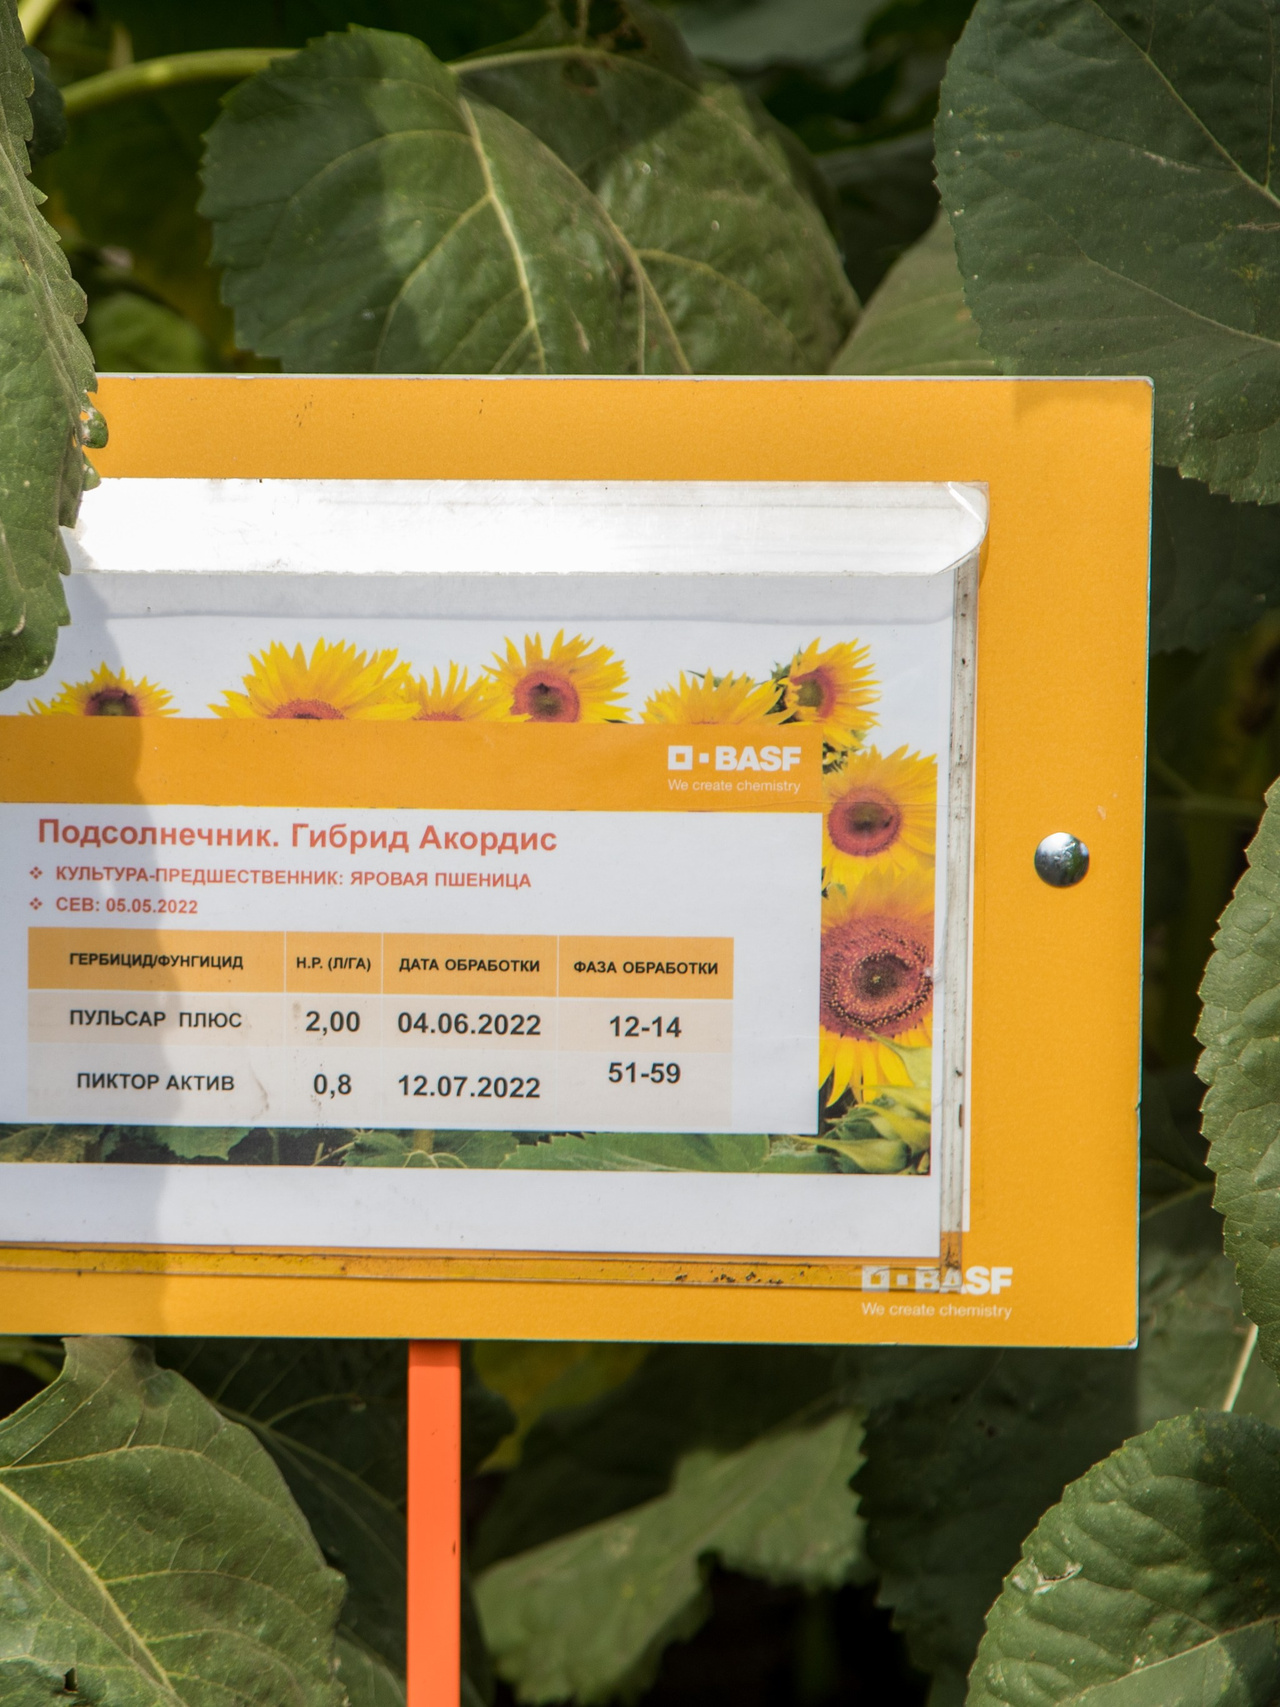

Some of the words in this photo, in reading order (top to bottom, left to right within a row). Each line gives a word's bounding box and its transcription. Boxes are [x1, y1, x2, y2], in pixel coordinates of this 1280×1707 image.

[715, 745, 802, 772] BASF
[668, 779, 689, 791] We
[693, 780, 733, 792] create
[736, 780, 801, 795] chemistry
[38, 818, 279, 849] Подсолнечник.
[292, 822, 409, 853] Гибрид
[419, 825, 558, 857] Акордис
[56, 866, 344, 886] КУЛЬТУРА-ПРЕДШЕСТВЕННИК:
[350, 871, 428, 887] ЯРОВАЯ
[435, 872, 532, 889] ПШЕНИЦА
[56, 896, 101, 912] СЕВ:
[106, 898, 199, 915] 05.05.2022
[69, 952, 244, 970] ГЕРБИЦИД/ФУНГИЦИД
[296, 956, 324, 970] Н.Р.
[327, 957, 372, 972] (Л/ГА)
[398, 957, 439, 973] ДАТА
[444, 958, 541, 973] ОБРАБОТКИ
[573, 960, 617, 974] ФАЗА
[622, 961, 718, 975] ОБРАБОТКИ
[69, 1009, 166, 1027] ПУЛЬСАР
[178, 1012, 243, 1029] ПЛЮС
[305, 1011, 361, 1036] 2,00
[397, 1012, 542, 1036] 04.06.2022
[609, 1015, 682, 1039] 12-14
[76, 1072, 160, 1090] ПИКТОР
[165, 1074, 235, 1091] АКТИВ
[608, 1061, 682, 1084] 51-59
[313, 1073, 352, 1099] 0,8
[398, 1074, 541, 1099] 12.07.2022
[915, 1265, 1013, 1296] BASF
[862, 1302, 885, 1316] We
[889, 1303, 935, 1317] create
[939, 1303, 1012, 1320] chemistry
